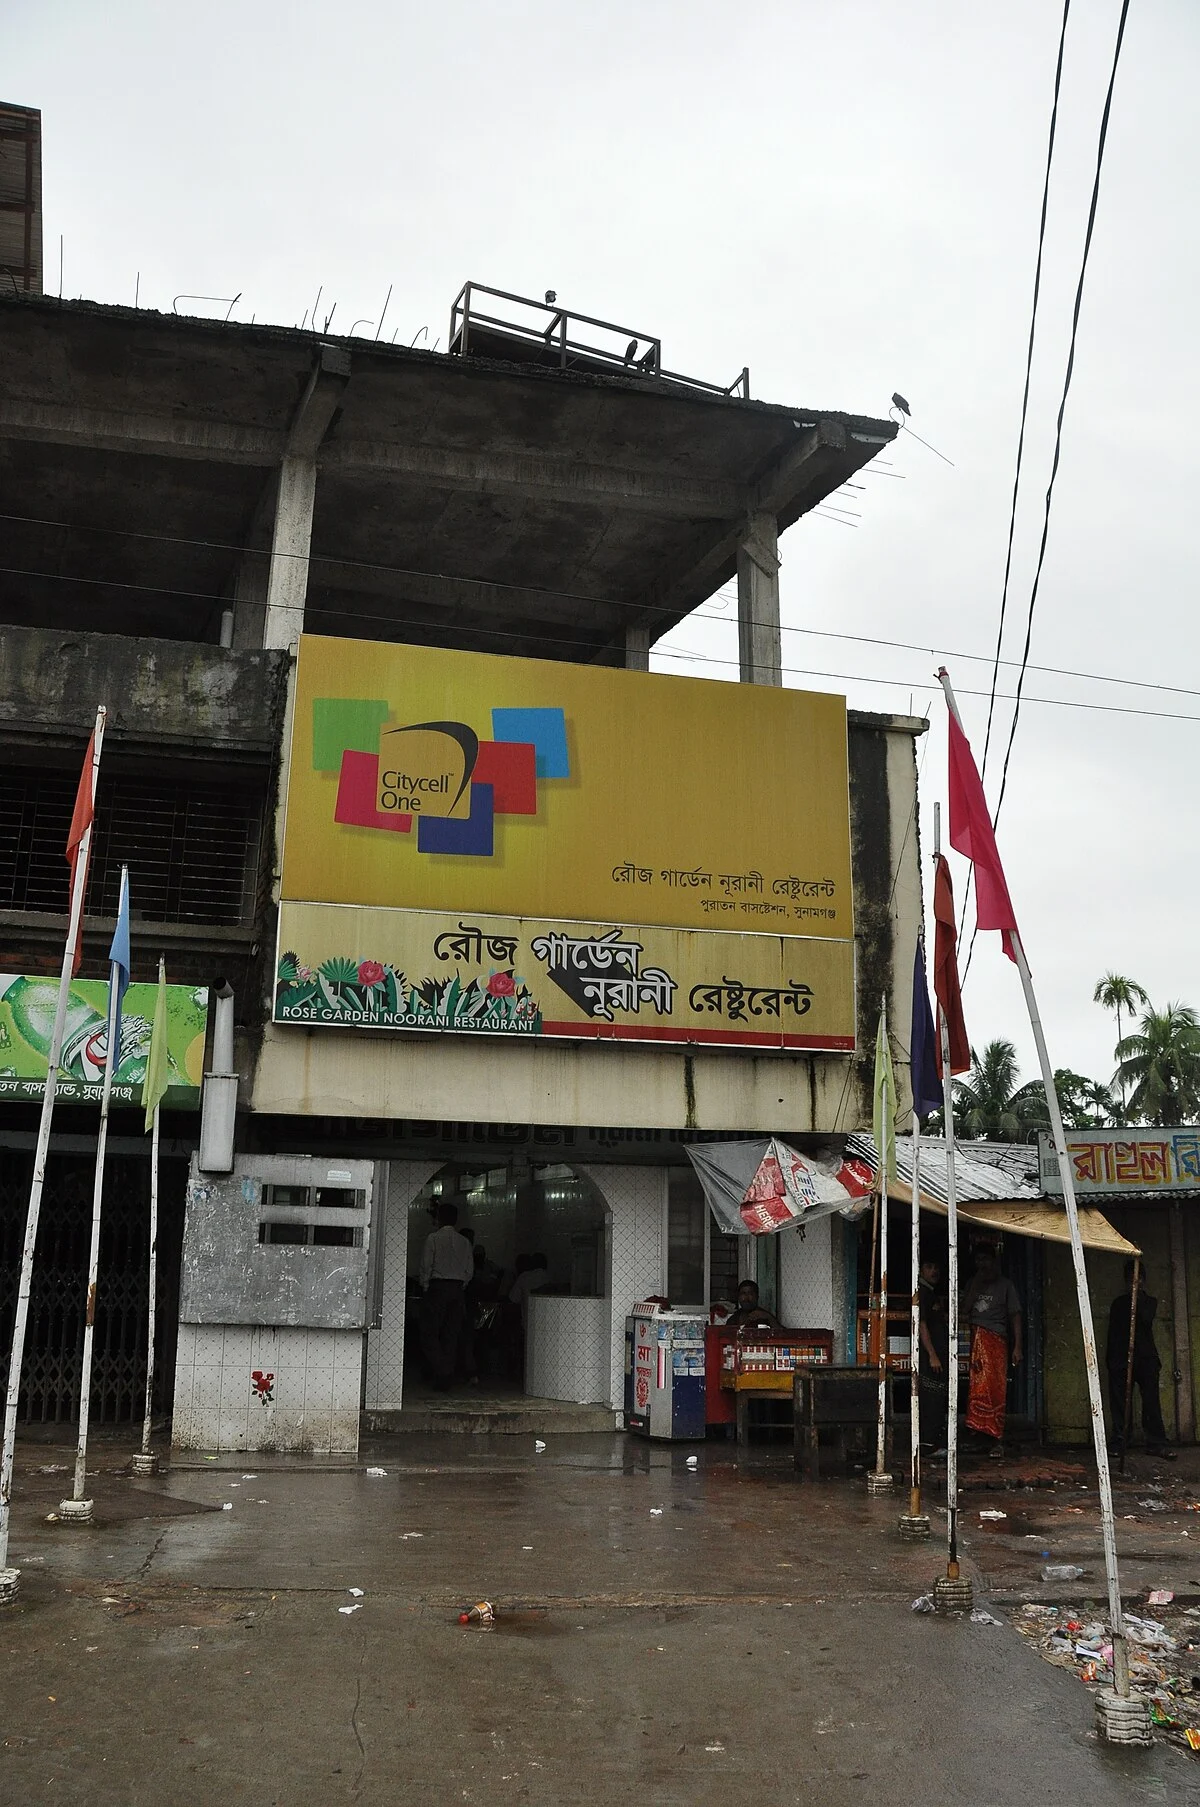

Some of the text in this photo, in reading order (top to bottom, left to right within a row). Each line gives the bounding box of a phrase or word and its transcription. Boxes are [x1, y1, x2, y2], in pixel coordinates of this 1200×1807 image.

[381, 791, 421, 811] One
[611, 860, 836, 900] রৌজ গার্ডেন নূরানী রেষ্টুরেন্ট
[700, 899, 736, 913] পুরাতন
[793, 905, 837, 921] সুনামগঞ্জ
[433, 921, 644, 975] রৌজ গার্ডেন
[579, 966, 815, 1022] নূরানী রেষ্টুরেন্ট
[282, 1006, 535, 1031] ROSE GARDEN NOORANI RESTAURANT
